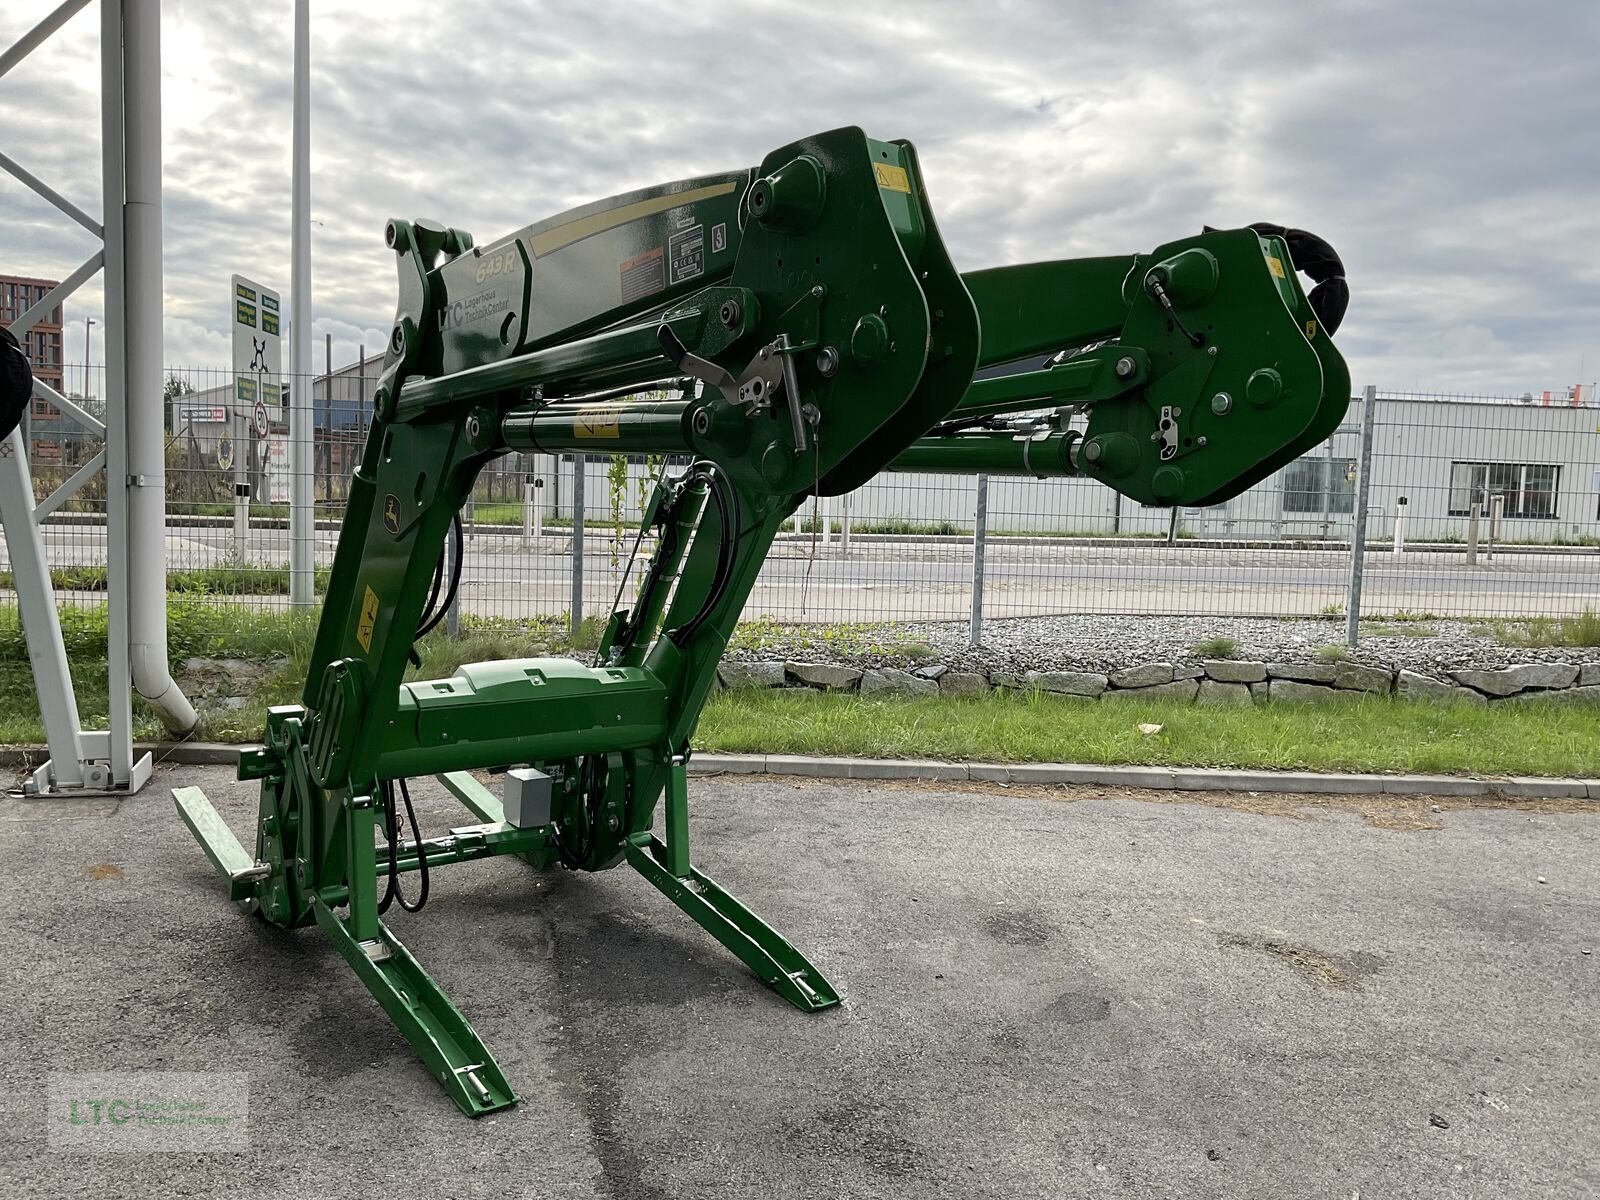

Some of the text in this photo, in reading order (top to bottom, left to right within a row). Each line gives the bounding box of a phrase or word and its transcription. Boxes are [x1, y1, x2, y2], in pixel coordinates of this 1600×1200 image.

[465, 290, 496, 309] Lagerhaus
[438, 300, 510, 333] LTC TechnikCenter
